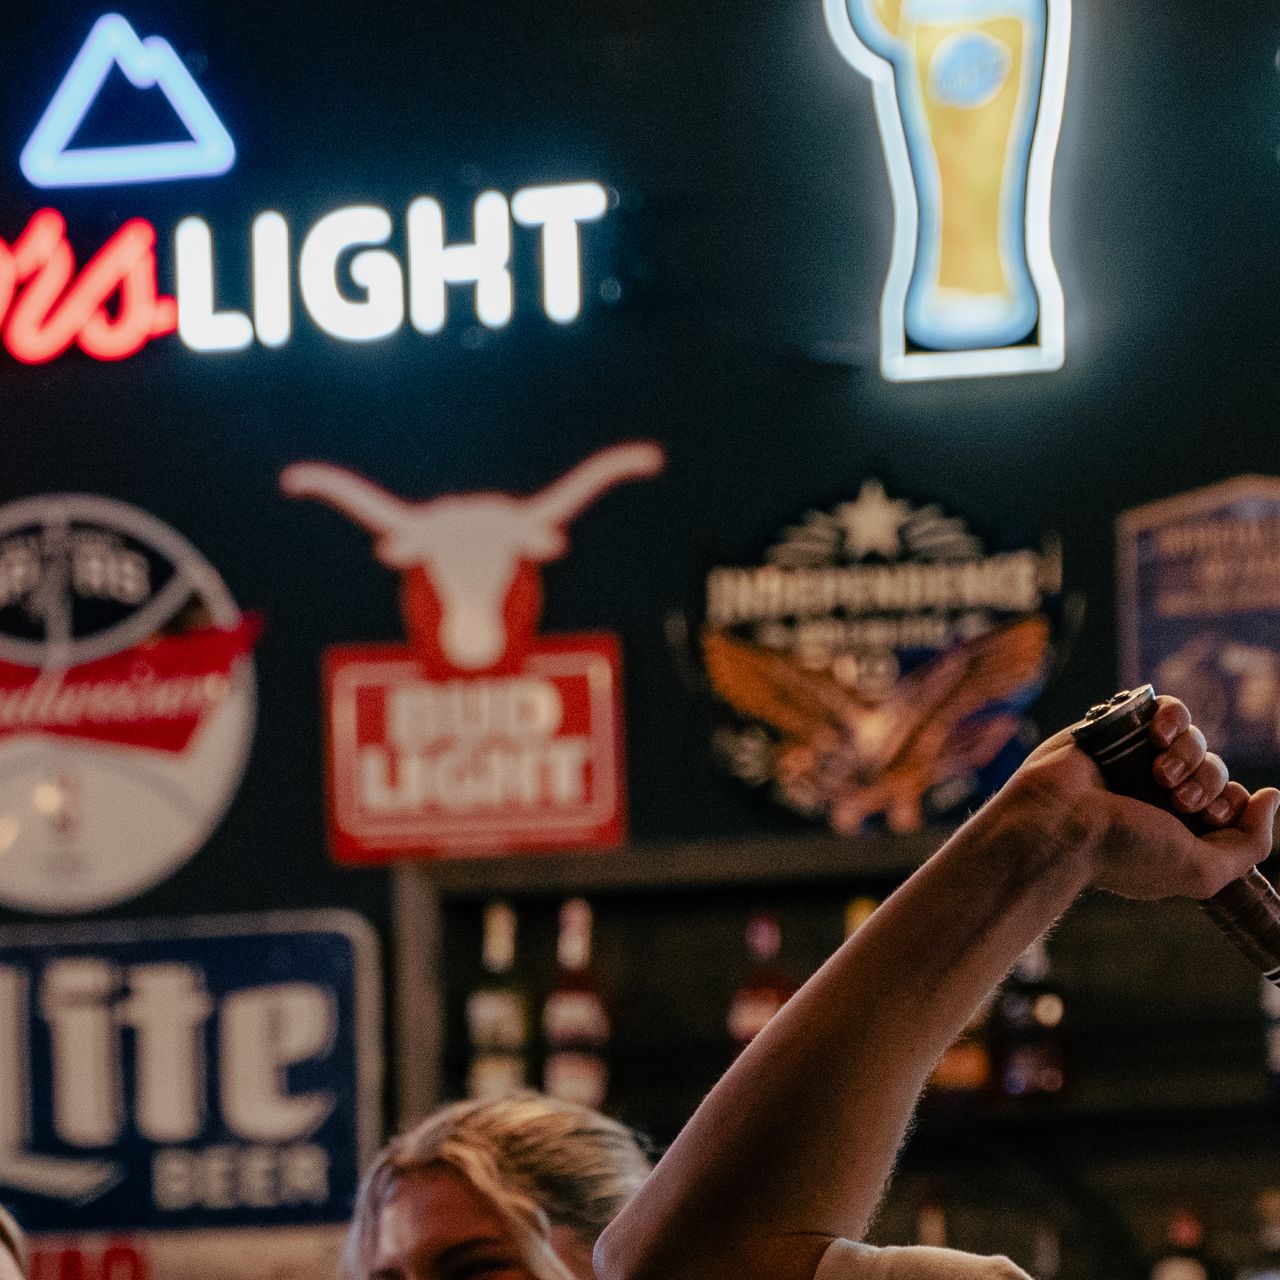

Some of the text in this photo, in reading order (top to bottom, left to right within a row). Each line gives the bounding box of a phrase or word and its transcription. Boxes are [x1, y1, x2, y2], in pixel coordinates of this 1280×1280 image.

[175, 181, 609, 353] LIGHT
[387, 678, 563, 748] BUD
[361, 738, 595, 812] LIGHT
[150, 1142, 330, 1211] BEER
